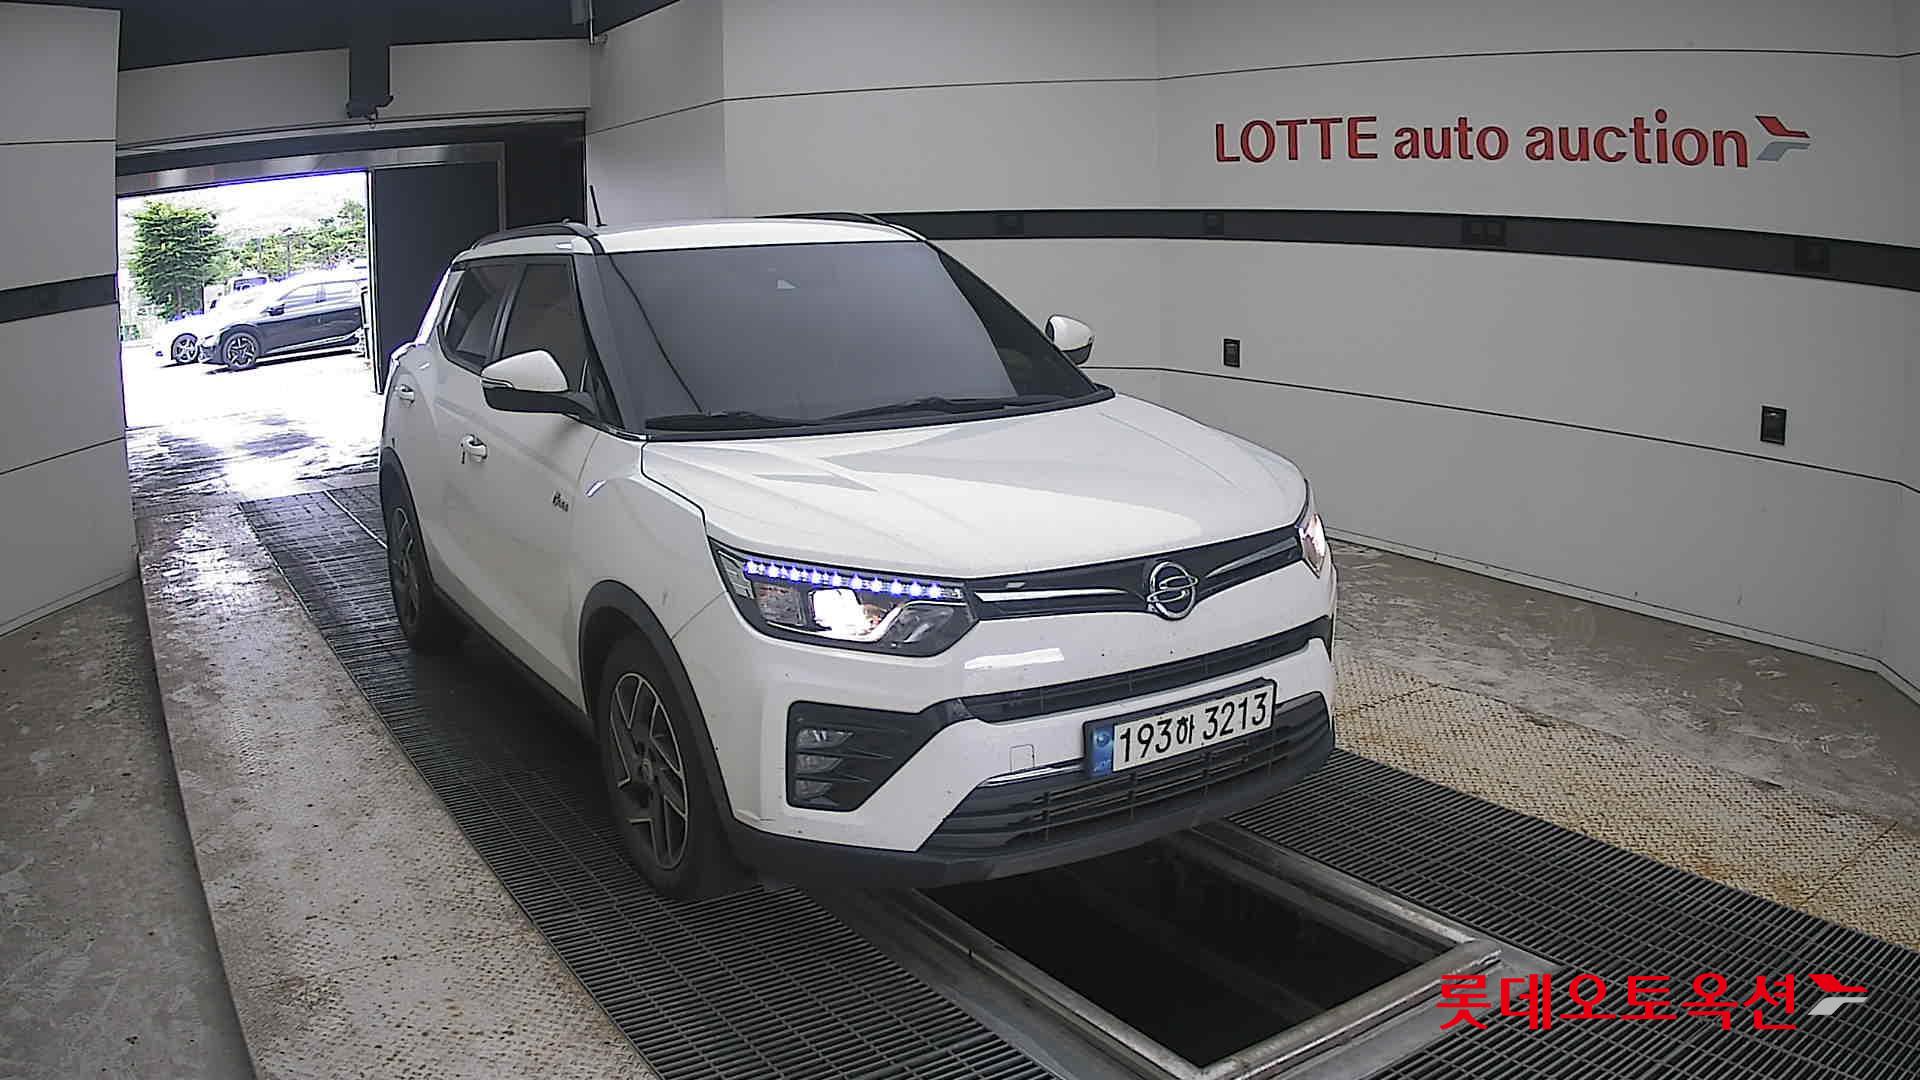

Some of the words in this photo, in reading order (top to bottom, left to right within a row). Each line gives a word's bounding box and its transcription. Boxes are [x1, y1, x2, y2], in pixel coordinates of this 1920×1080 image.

[1215, 115, 1378, 162] LOTTE
[1394, 116, 1507, 160] auto
[1525, 109, 1749, 168] auction
[1119, 714, 1195, 763] 193하
[1203, 692, 1268, 740] 3213
